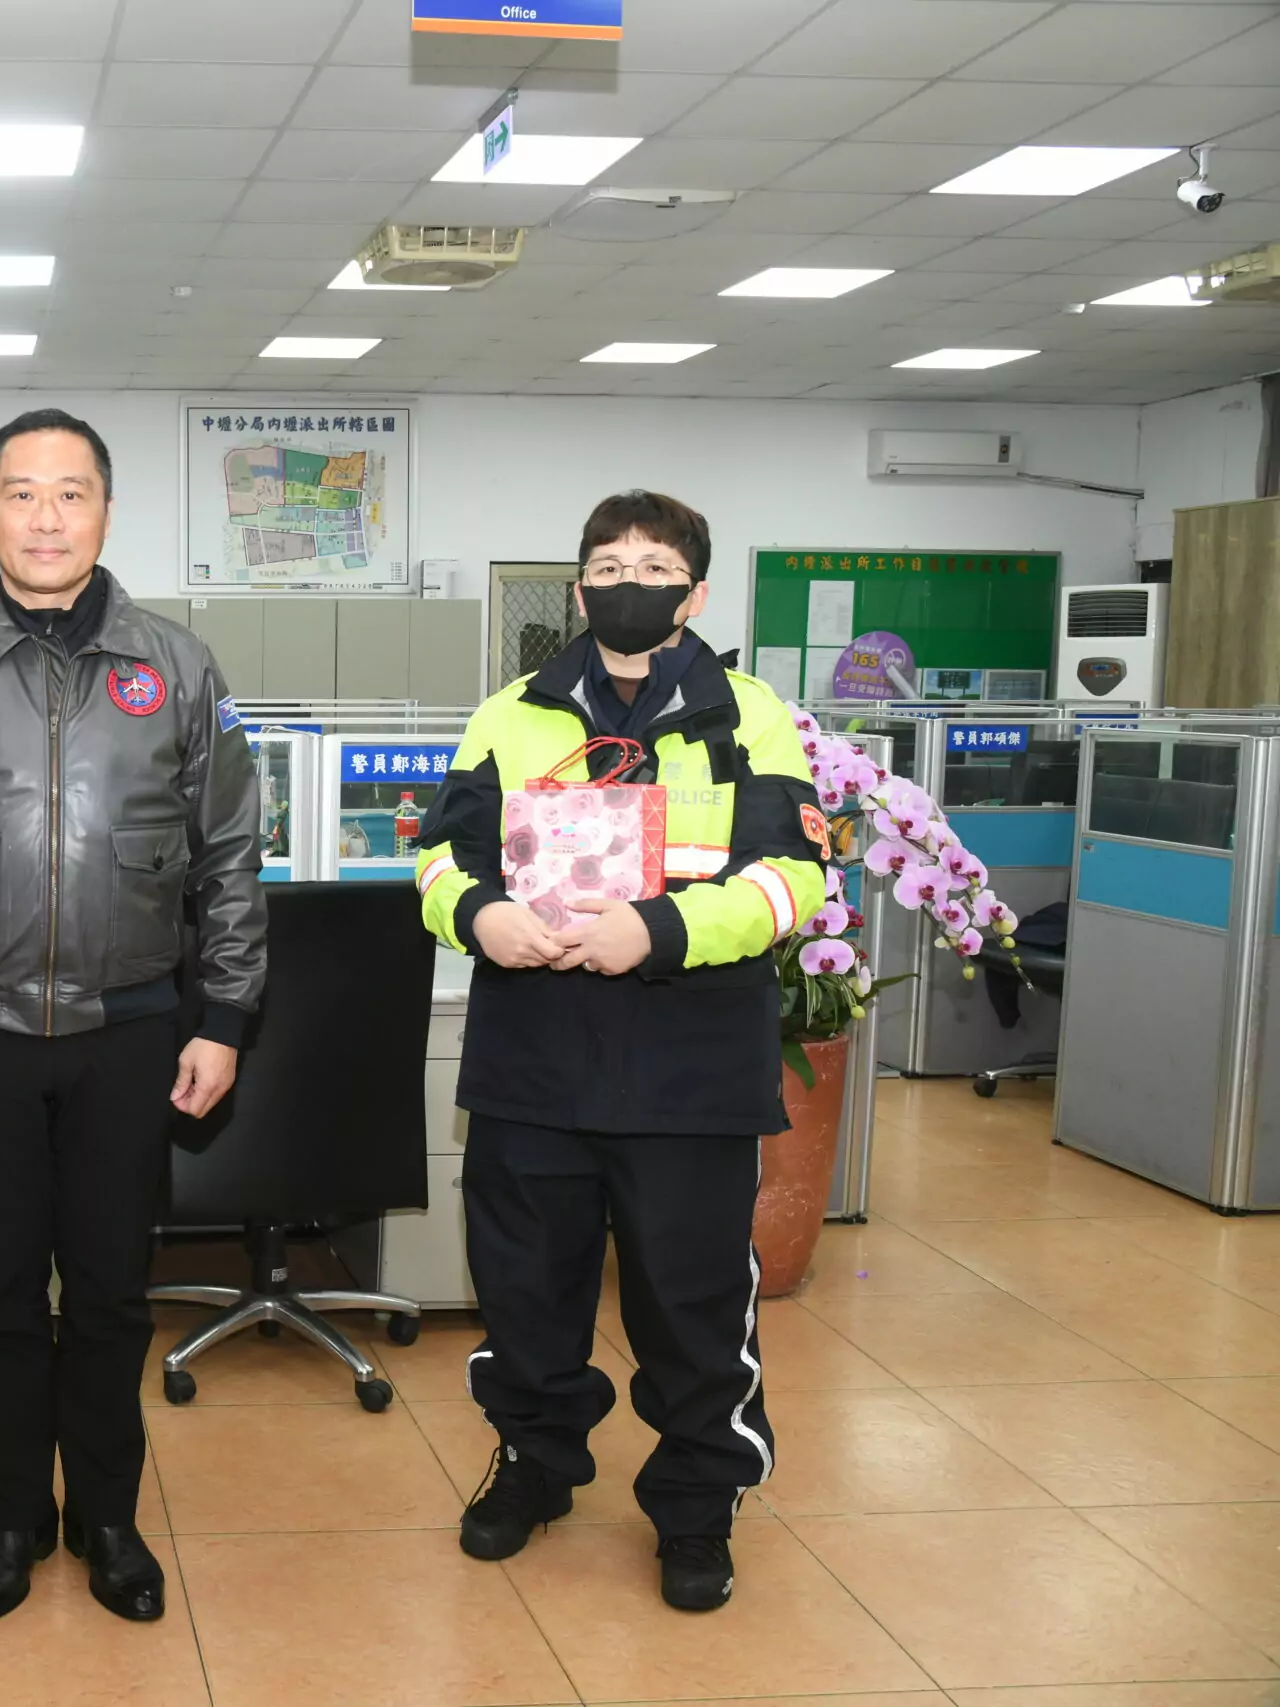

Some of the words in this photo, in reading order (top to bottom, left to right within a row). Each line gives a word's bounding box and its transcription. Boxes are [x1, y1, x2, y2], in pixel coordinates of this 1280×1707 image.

[501, 6, 537, 19] Office
[202, 415, 396, 433] 中壢分局內壢派出所轄區圖
[852, 652, 880, 669] 165
[350, 753, 449, 774] 警員鄭海茵
[667, 789, 722, 806] OLICE
